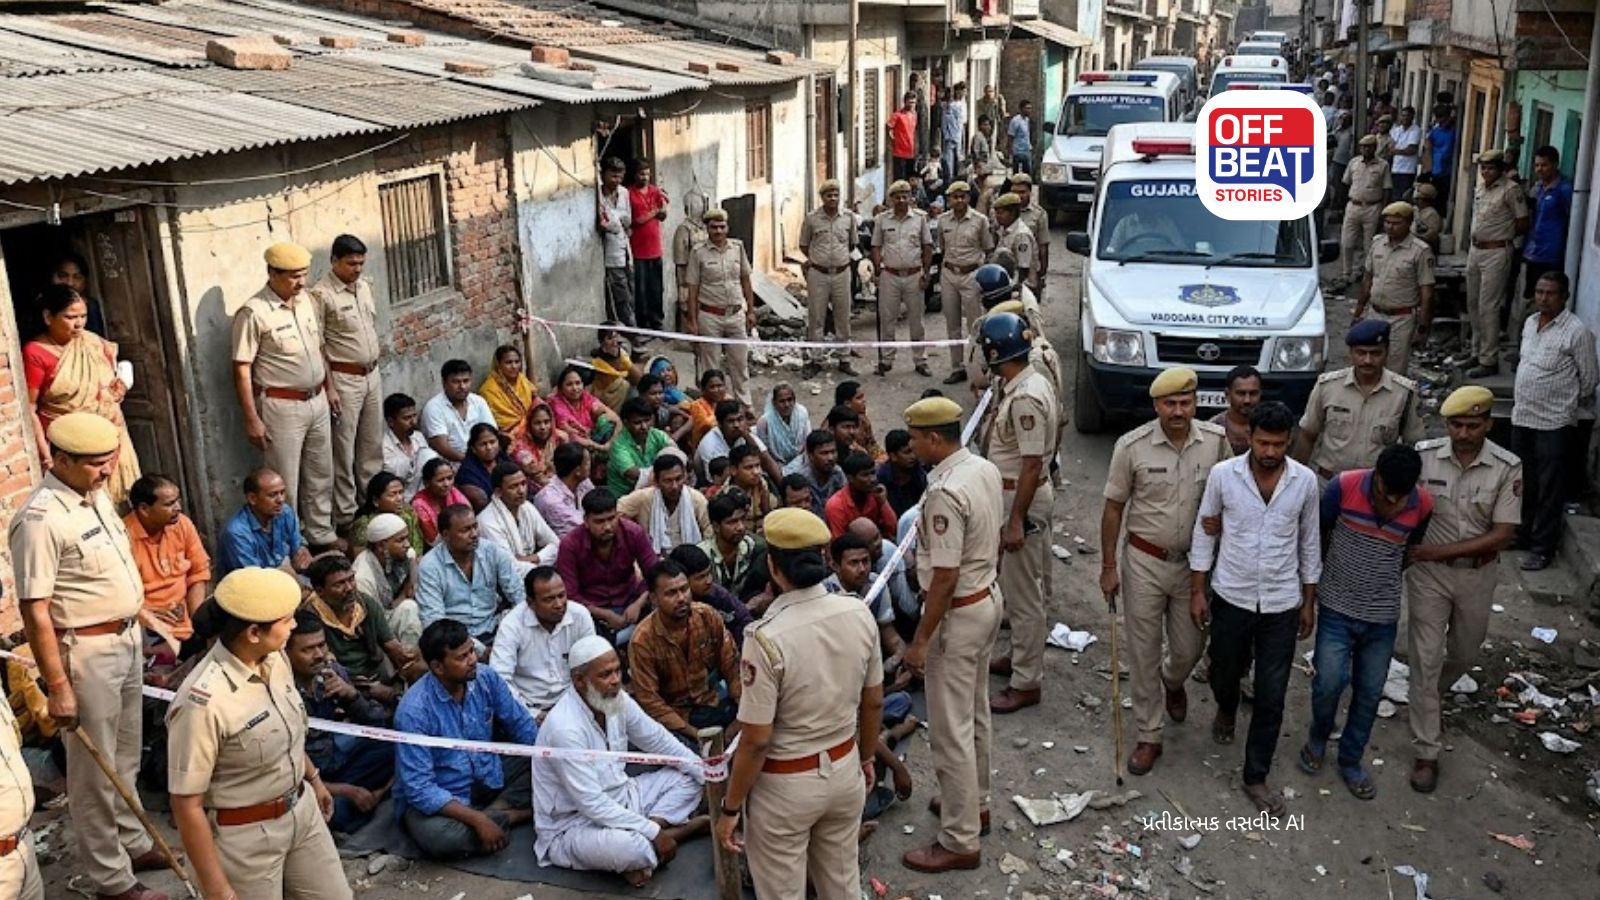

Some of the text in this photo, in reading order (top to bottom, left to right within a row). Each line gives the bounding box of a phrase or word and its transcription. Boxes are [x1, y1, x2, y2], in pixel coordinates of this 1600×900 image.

[1130, 184, 1198, 197] GUJARA
[1151, 313, 1268, 325] VADODARA CITY POLICE
